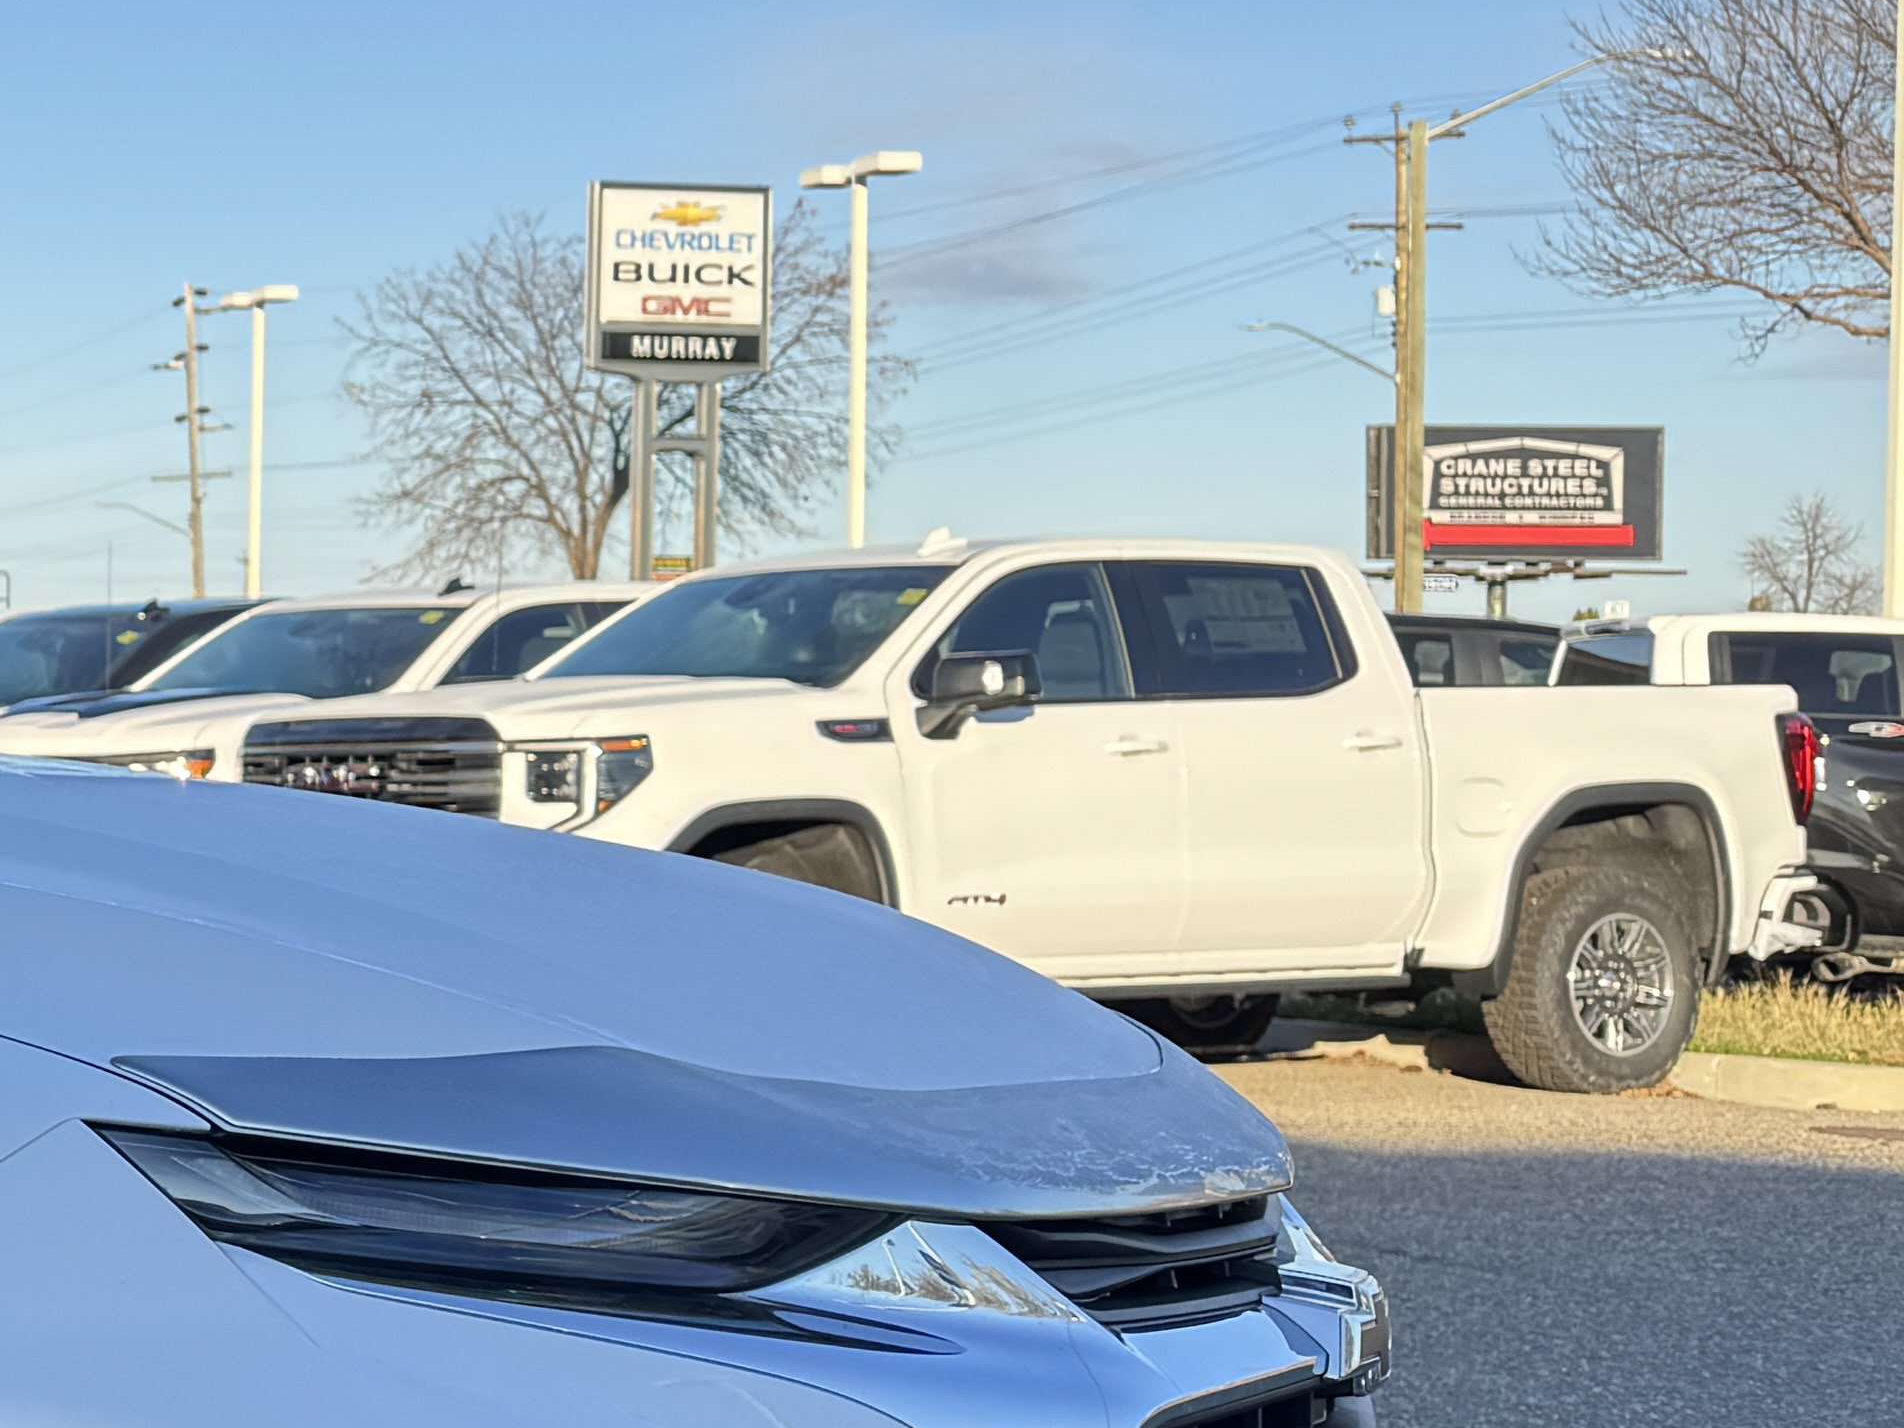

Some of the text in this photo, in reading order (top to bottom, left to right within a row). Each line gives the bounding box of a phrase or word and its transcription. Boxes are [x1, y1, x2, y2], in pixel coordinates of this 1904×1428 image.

[614, 228, 757, 253] CHEVROLET
[612, 261, 755, 287] BUICK
[641, 294, 732, 317] GMC
[630, 335, 737, 360] MURRAY
[1440, 458, 1604, 477] CRANE STEEL
[1439, 477, 1597, 495] STRUCTURES
